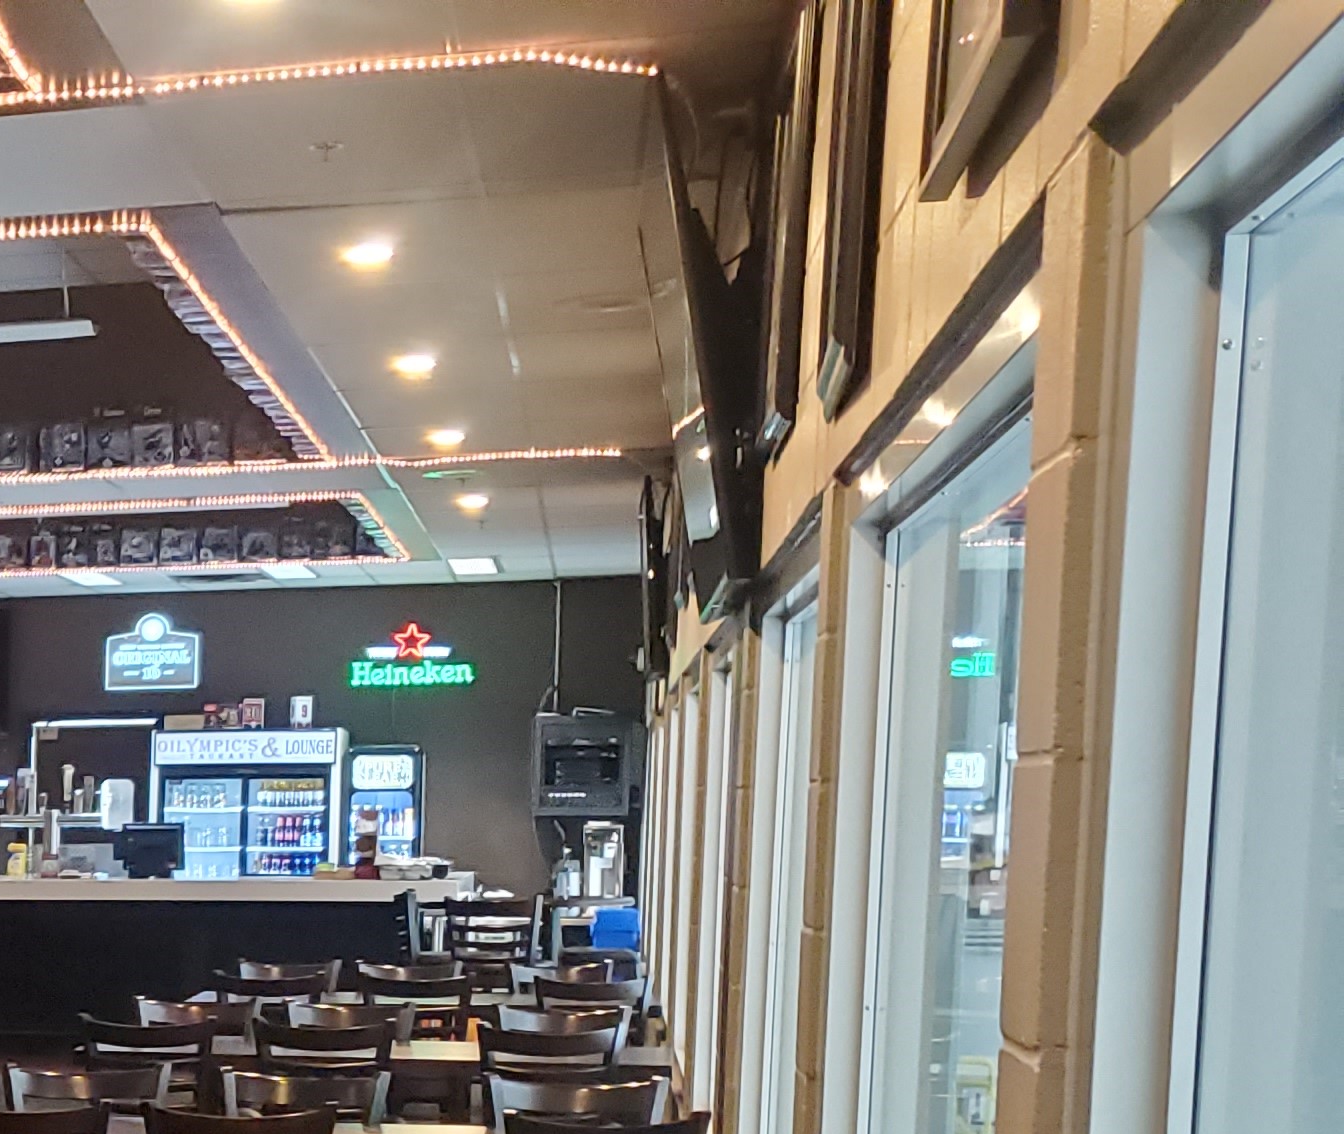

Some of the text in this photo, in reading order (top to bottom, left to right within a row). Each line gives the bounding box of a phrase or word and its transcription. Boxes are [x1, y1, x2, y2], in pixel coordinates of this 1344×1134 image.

[350, 660, 476, 687] Heineken
[261, 737, 281, 758] &
[285, 739, 333, 755] LOUNGE
